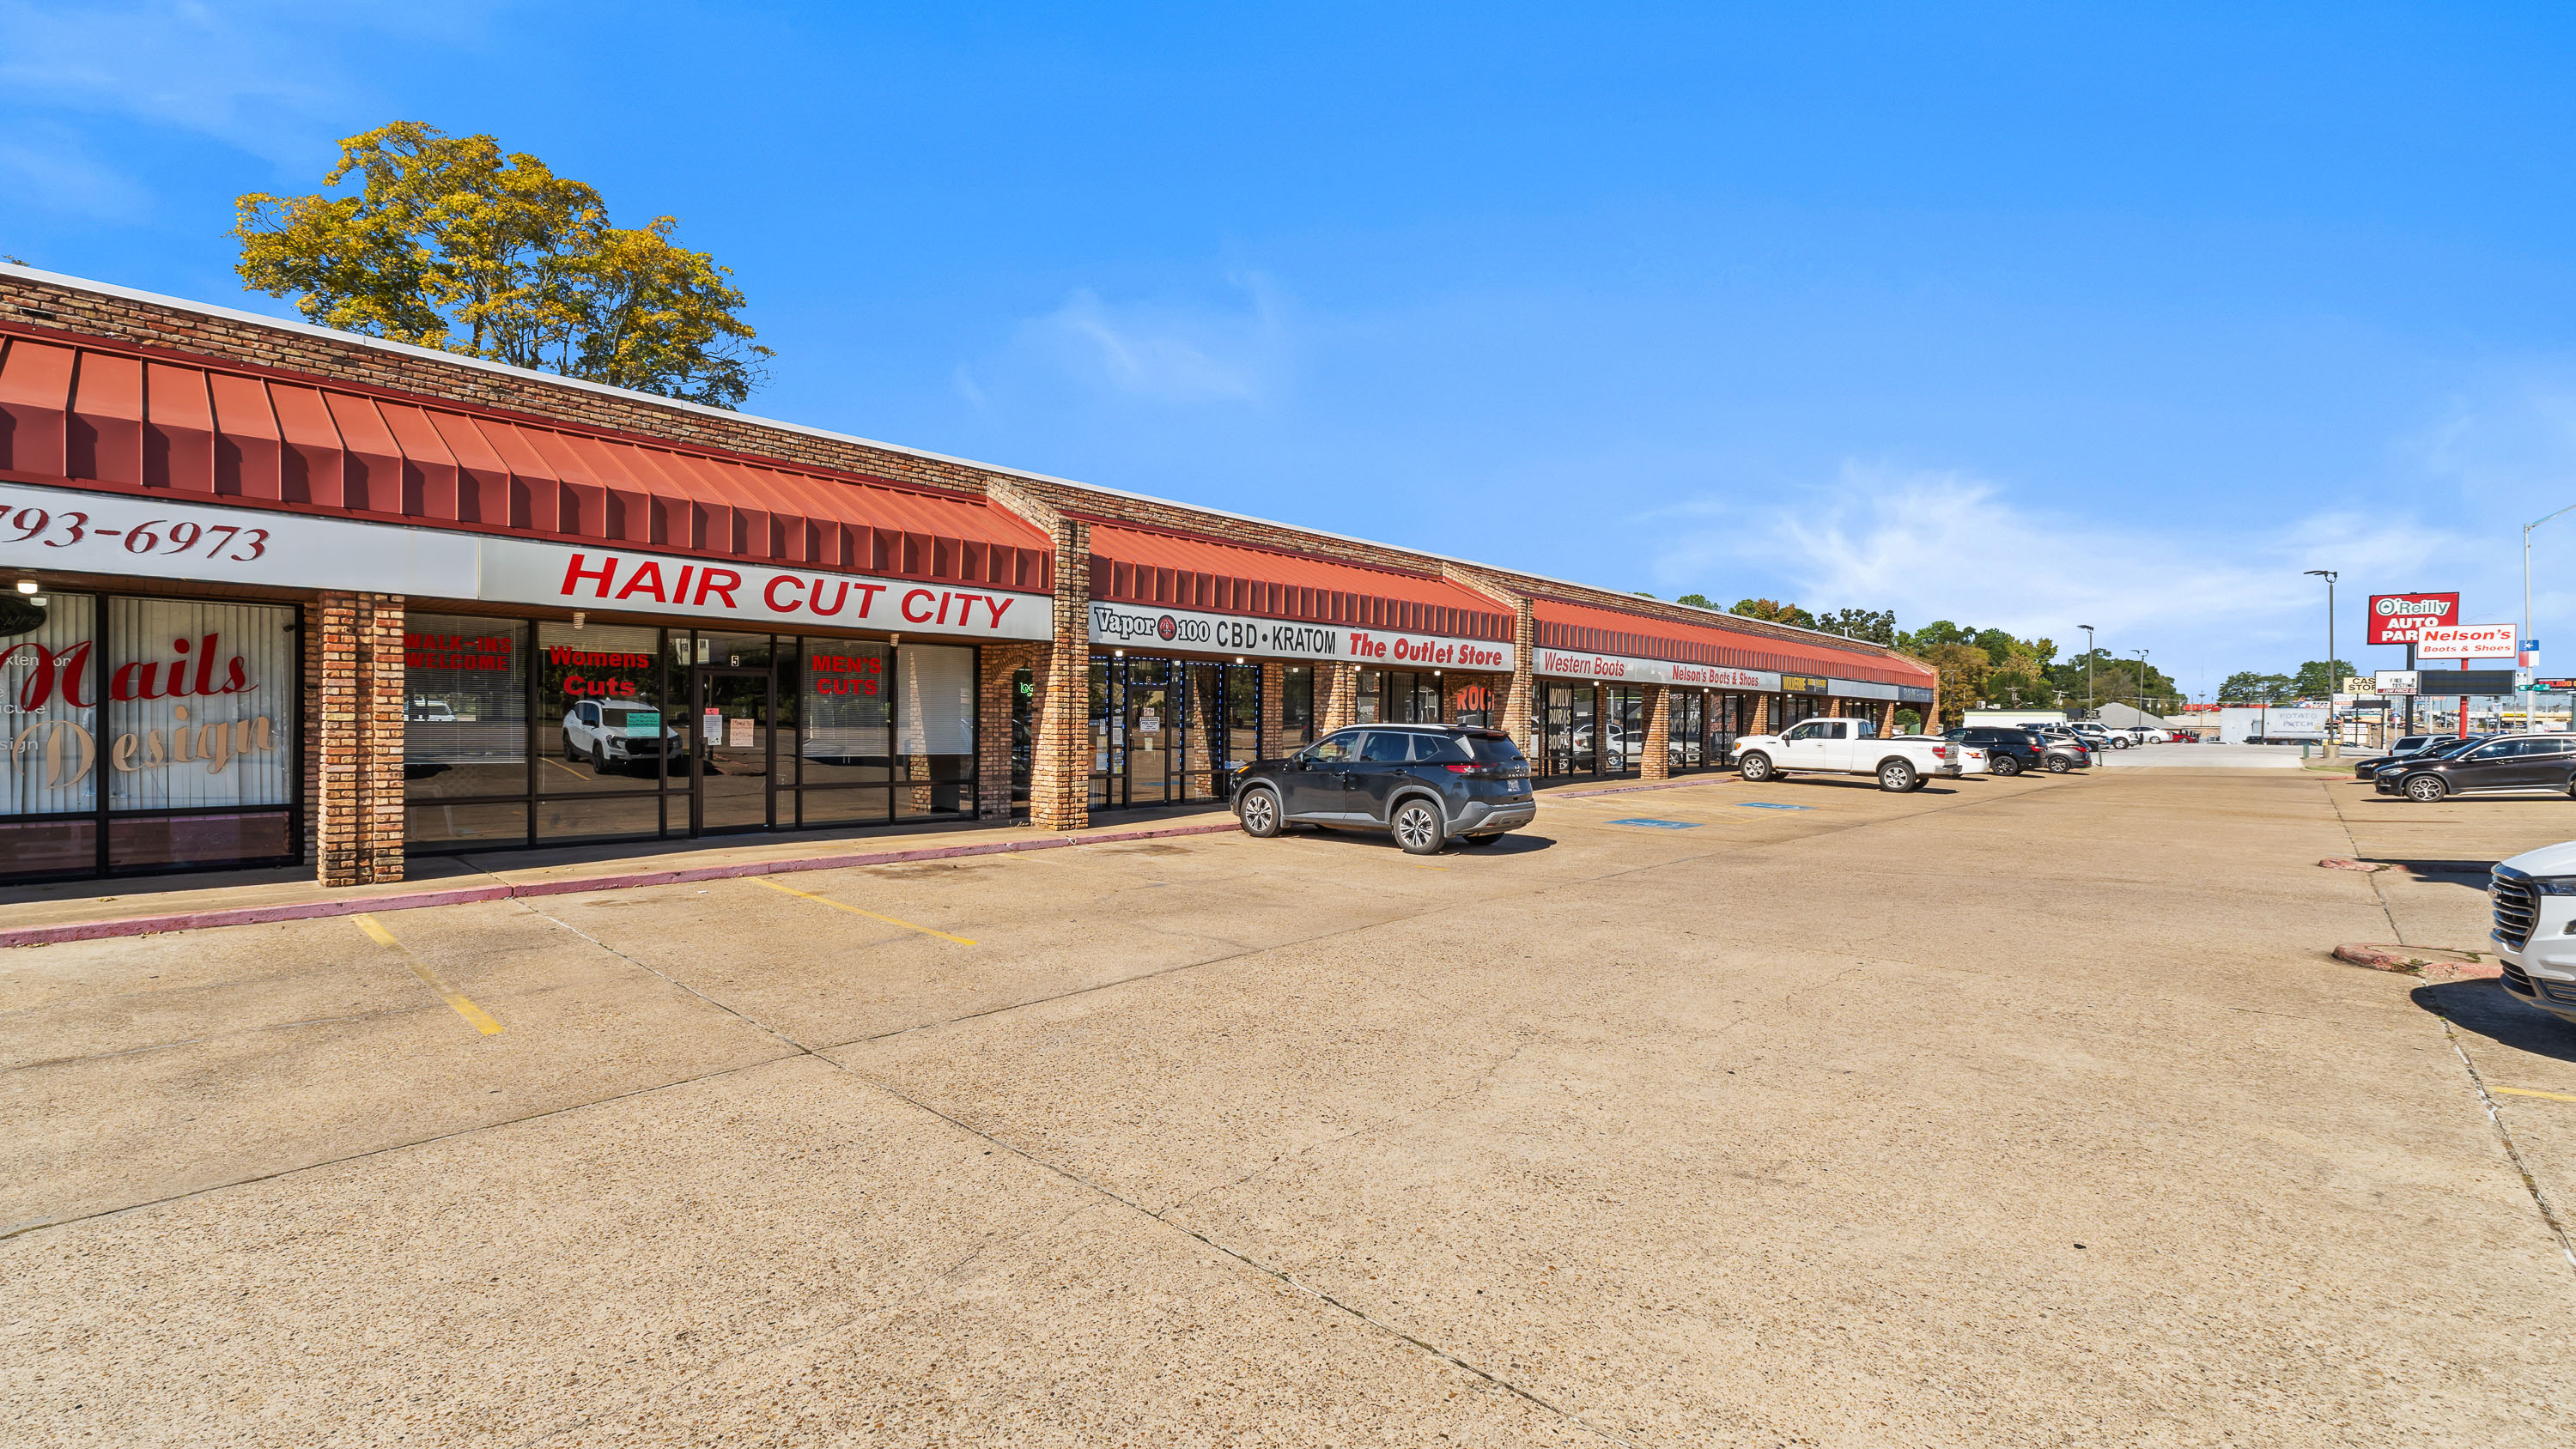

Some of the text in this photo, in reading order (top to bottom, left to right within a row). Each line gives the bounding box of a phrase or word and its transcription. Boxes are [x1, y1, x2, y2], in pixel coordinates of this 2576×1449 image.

[560, 554, 1015, 629] HAIR CUT CITY
[2377, 598, 2450, 615] O'Reilly
[1094, 607, 1336, 655] Vapor 100 CBD KRATOM
[2387, 616, 2439, 628] AUTO
[404, 633, 513, 652] WALK-INS
[2381, 630, 2418, 641] PAR
[2424, 629, 2512, 641] Nelson's
[550, 646, 650, 669] Womens
[1350, 633, 1503, 666] The Outlet Store
[404, 652, 508, 670] WELCOME
[732, 656, 738, 666] 5
[812, 655, 882, 675] MEN'S
[1545, 652, 1625, 677] Western Boots
[0, 634, 259, 712] Nails
[1672, 664, 1759, 687] Nelson's Boots & Shoes
[563, 675, 636, 697] Cuts
[817, 678, 878, 696] CUTS
[1457, 686, 1494, 712] ROC
[12, 706, 278, 791] Design
